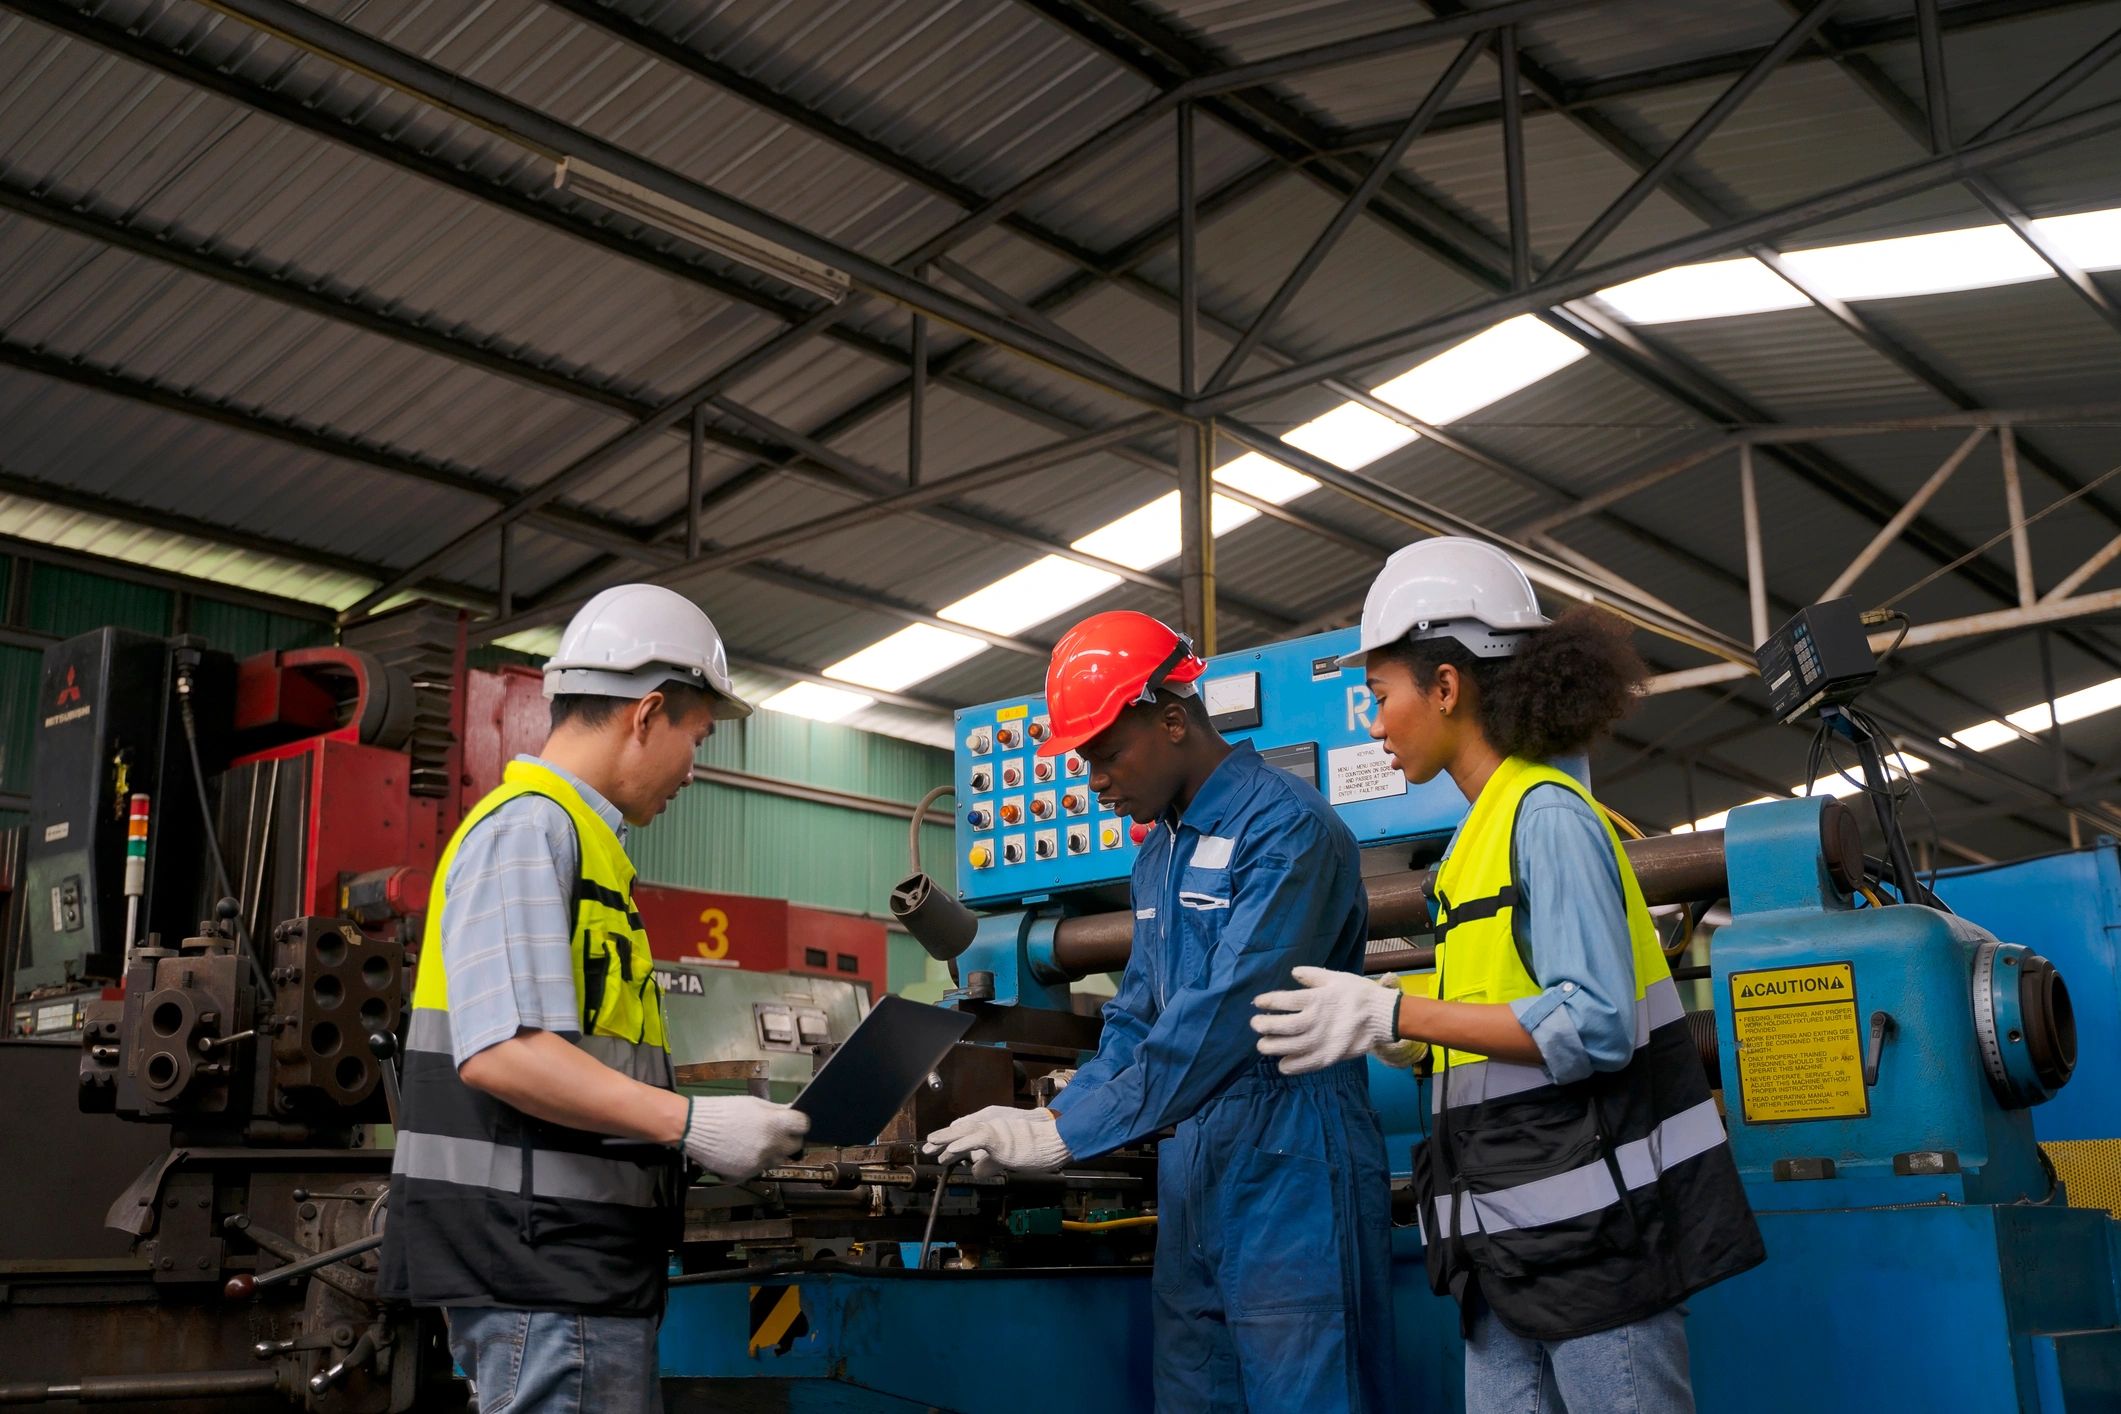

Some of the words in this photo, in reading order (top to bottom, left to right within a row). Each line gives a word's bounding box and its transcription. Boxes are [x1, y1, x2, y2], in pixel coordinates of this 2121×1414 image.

[1347, 687, 1371, 731] R
[1345, 769, 1371, 777] COUNTDOWN
[697, 908, 729, 960] 3
[1754, 976, 1830, 996] CAUTION
